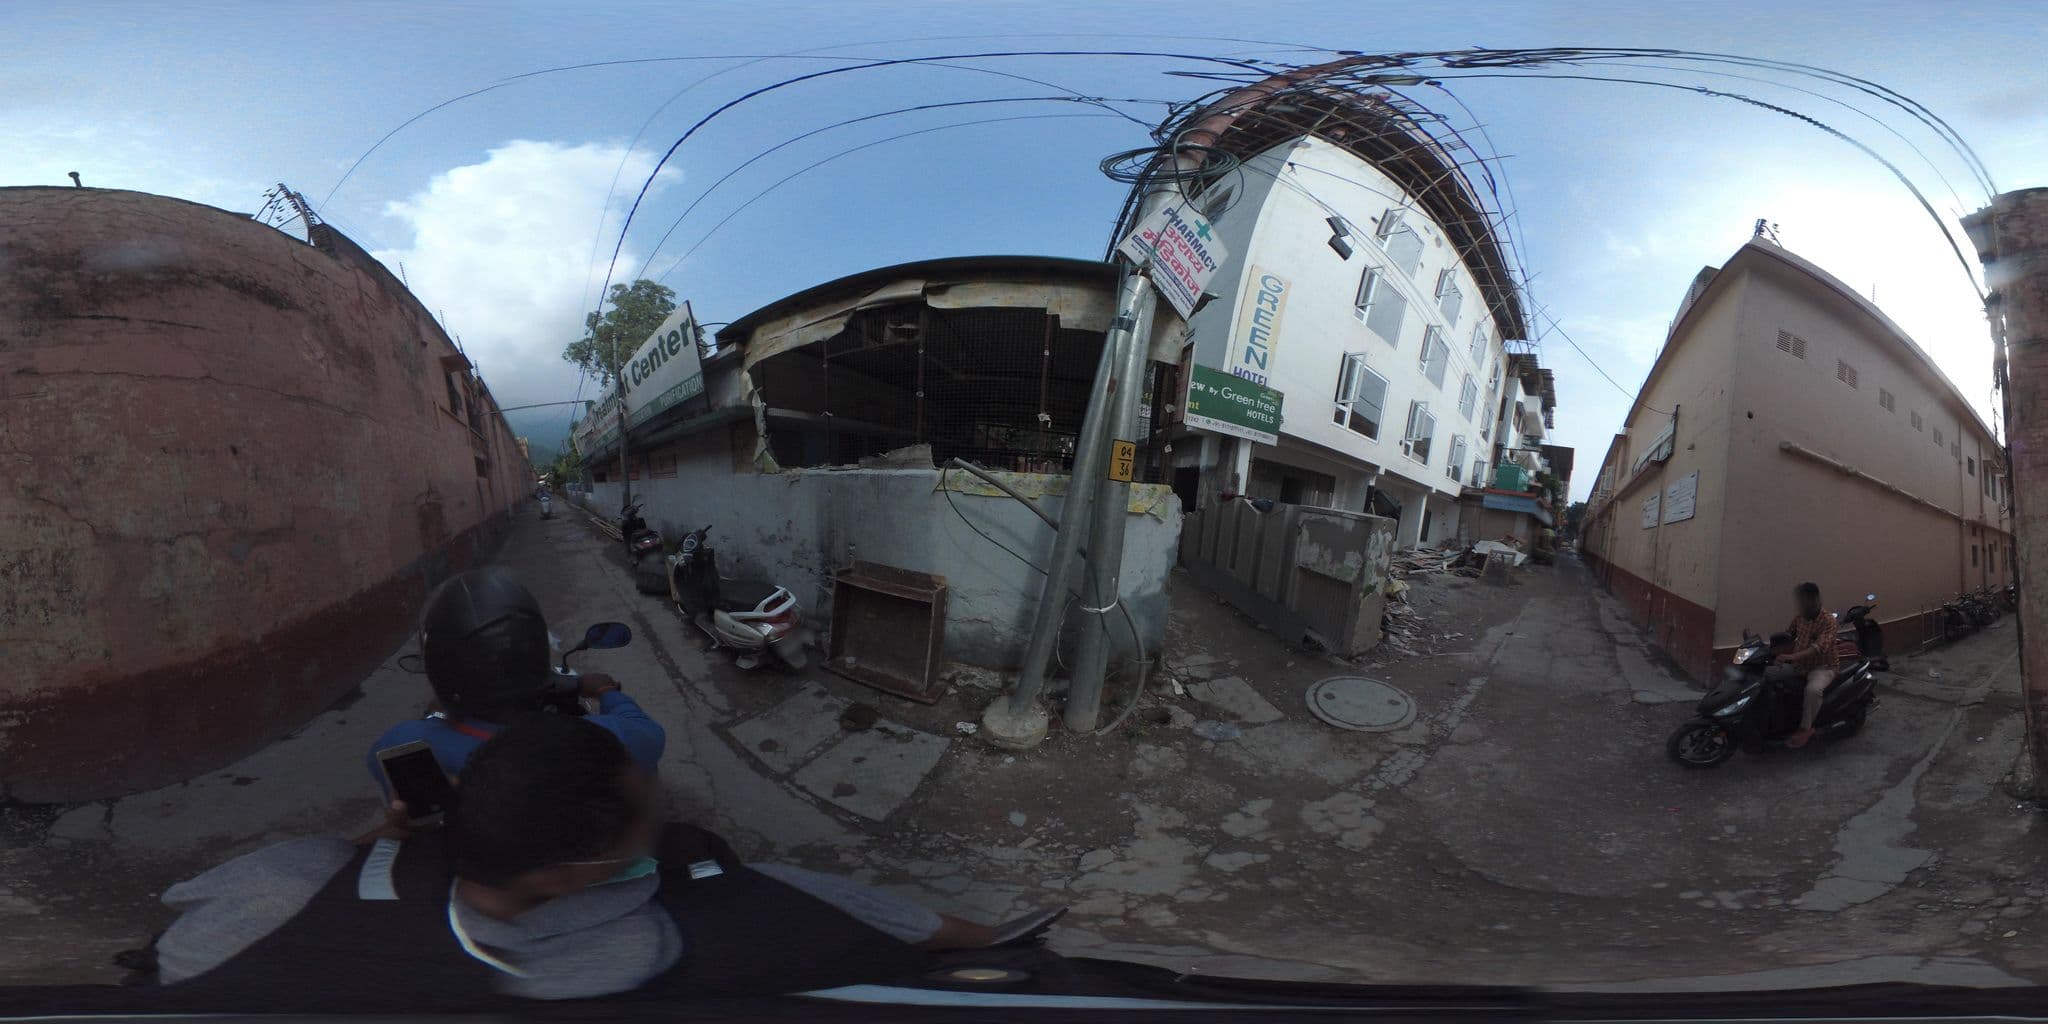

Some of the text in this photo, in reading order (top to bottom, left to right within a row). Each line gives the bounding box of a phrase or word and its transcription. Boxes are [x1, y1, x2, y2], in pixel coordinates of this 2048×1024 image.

[1162, 207, 1217, 273] PHARMACY
[1244, 274, 1284, 371] GREEN
[631, 317, 691, 387] Center
[1221, 386, 1255, 407] Green
[1246, 409, 1274, 424] HOTELS
[1120, 446, 1132, 458] 04
